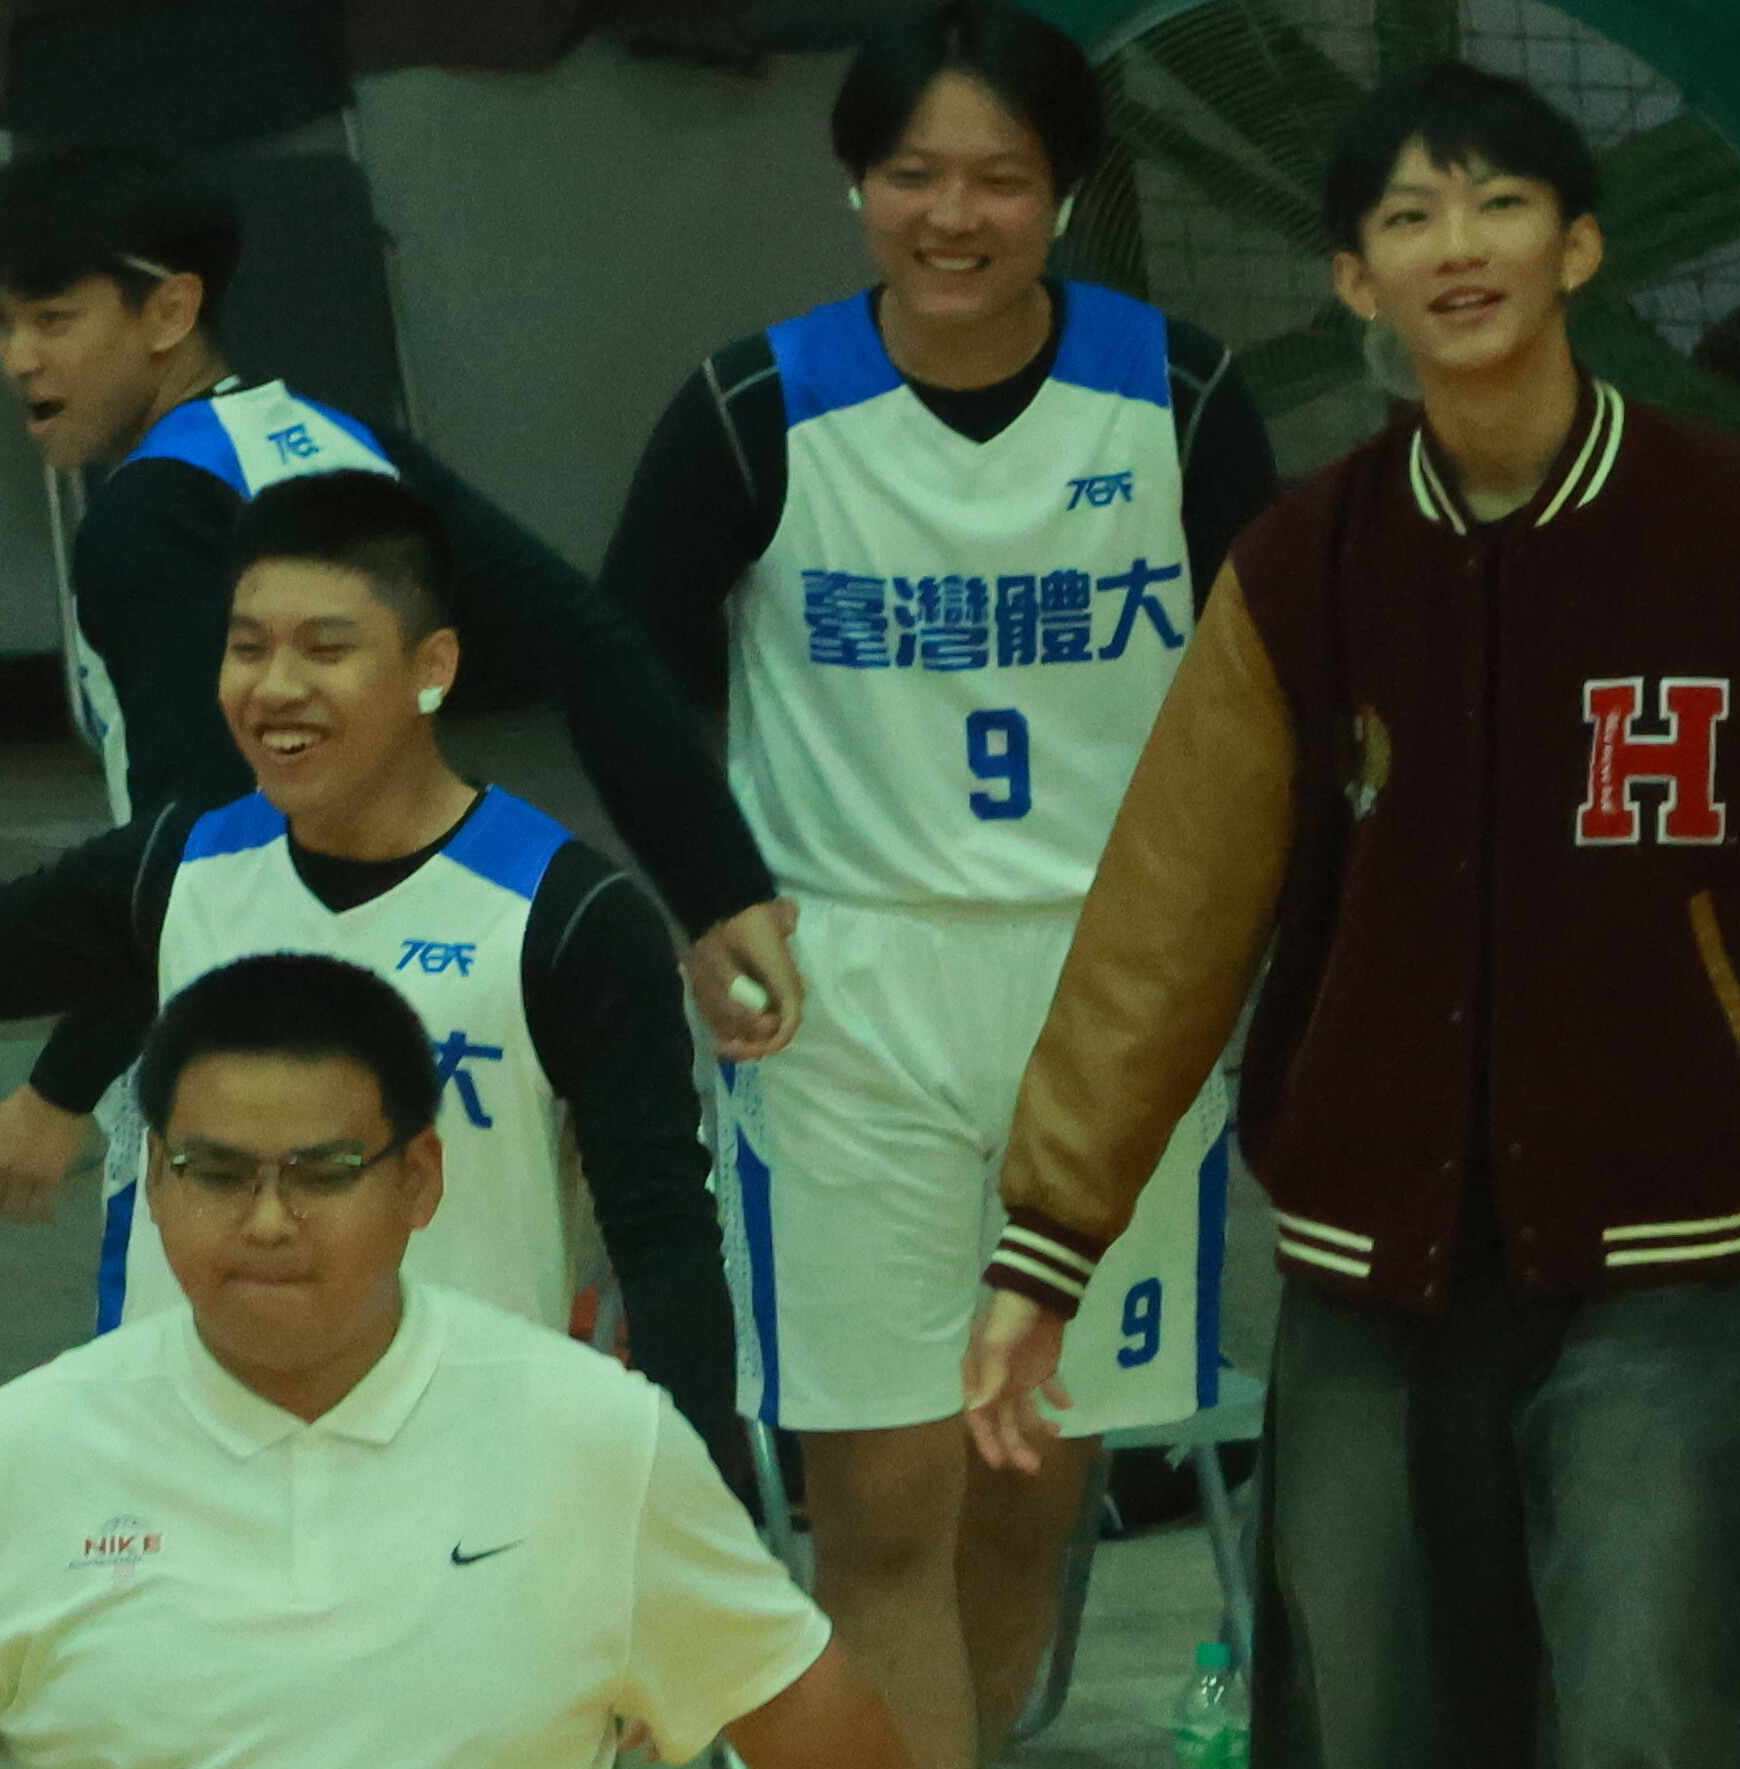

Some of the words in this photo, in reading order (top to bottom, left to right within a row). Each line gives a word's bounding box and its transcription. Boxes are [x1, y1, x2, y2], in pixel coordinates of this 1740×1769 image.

[801, 557, 1186, 673] 臺灣體大
[966, 708, 1033, 821] 9
[1575, 676, 1730, 846] H
[1116, 1276, 1163, 1369] 9
